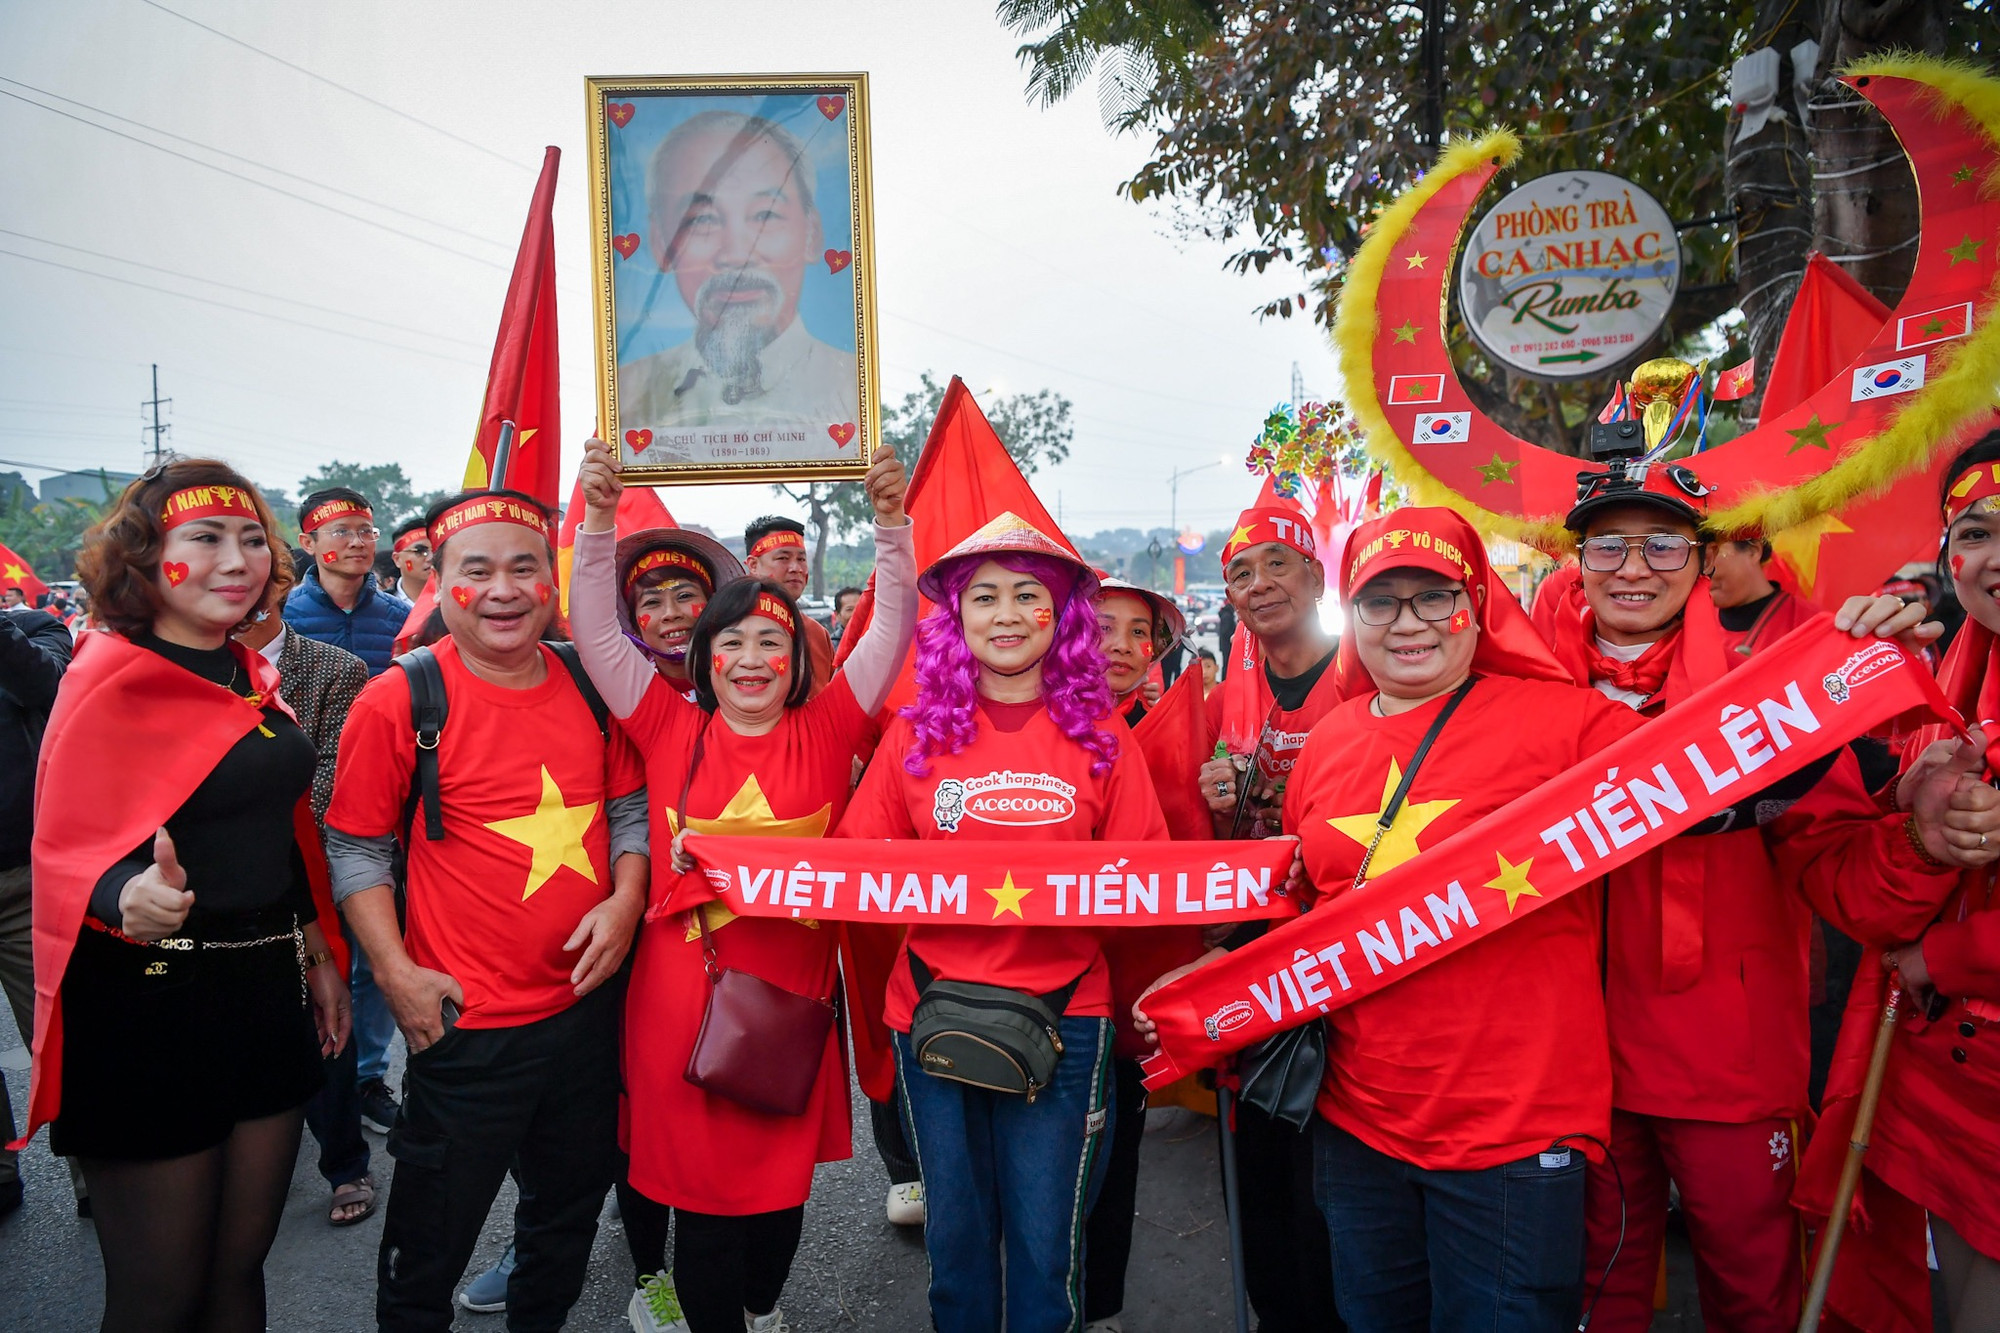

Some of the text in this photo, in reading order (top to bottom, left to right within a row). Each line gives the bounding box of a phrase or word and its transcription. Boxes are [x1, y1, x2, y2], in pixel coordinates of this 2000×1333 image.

[1496, 189, 1639, 240] PHÒNG TRÀ
[1478, 232, 1662, 278] CA NHẠC
[1501, 278, 1642, 335] Rumba
[702, 433, 728, 446] TỊCH
[754, 430, 773, 443] CHÍ
[777, 432, 806, 442] MINH
[175, 488, 214, 512] NAM
[317, 500, 350, 518] VIỆT NAM
[445, 503, 540, 530] VIỆT NAM VÔ ĐỊCH
[763, 533, 796, 548] VIỆT NAM
[1359, 537, 1384, 567] NAM
[1412, 530, 1431, 548] VÔ
[1434, 537, 1463, 566] ĐỊCH
[655, 551, 688, 564] VIỆT
[760, 598, 789, 622] VÔ ĐỊCH
[1838, 657, 1858, 676] Cook
[965, 773, 1074, 795] Cook happiness
[1248, 680, 1821, 1023] VIỆT NAM TIẾN LÊN
[737, 857, 1272, 918] VIỆT NAM TIẾN LÊN
